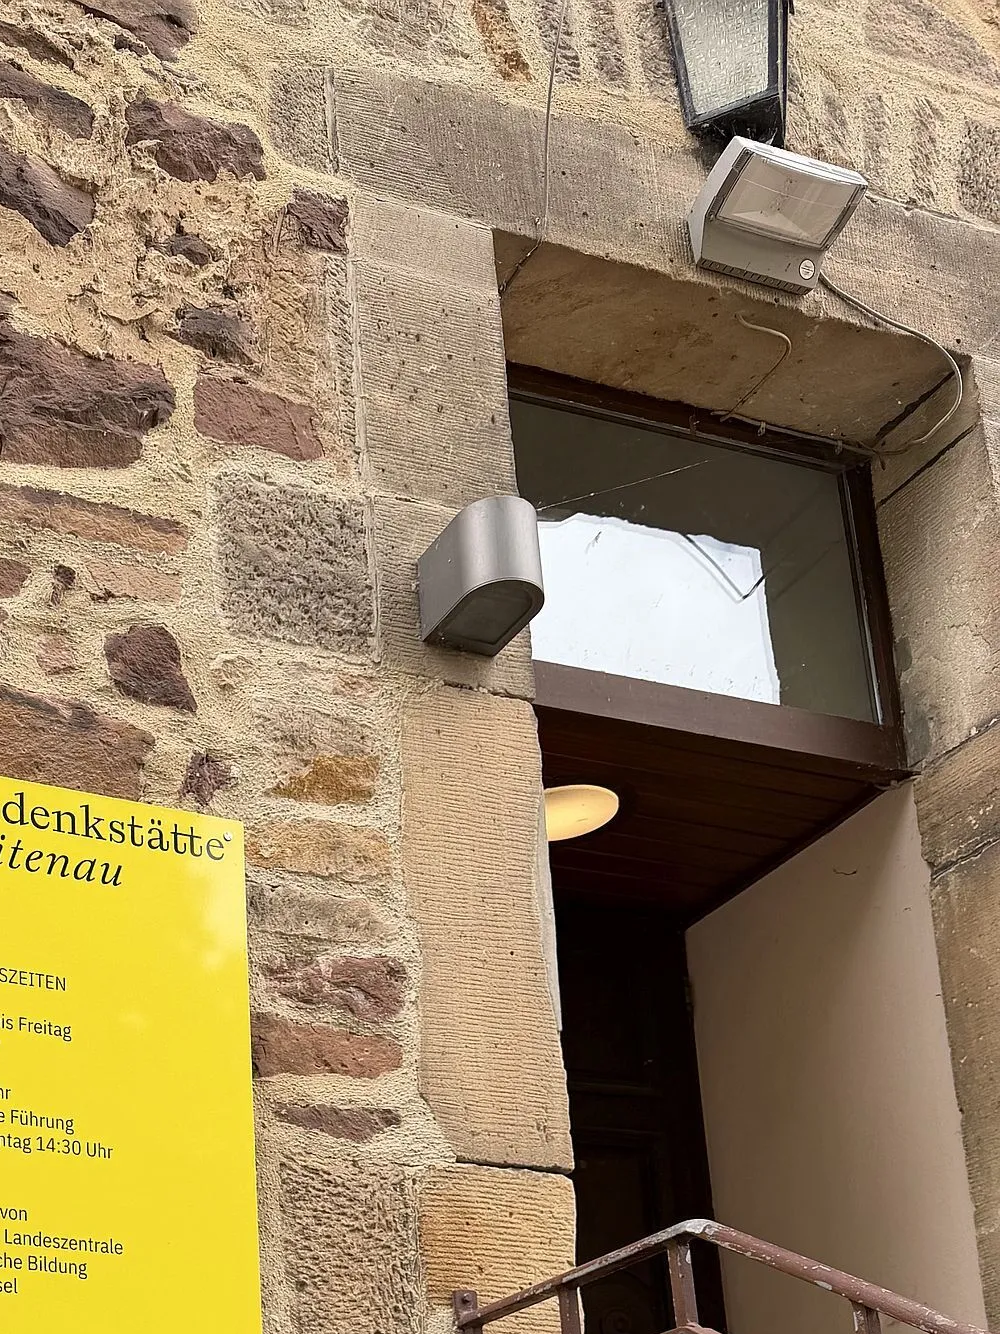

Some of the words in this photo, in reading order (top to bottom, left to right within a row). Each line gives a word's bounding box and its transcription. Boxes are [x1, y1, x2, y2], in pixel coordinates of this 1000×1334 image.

[19, 1017, 72, 1042] Freitag
[11, 1109, 74, 1135] Führung
[36, 1136, 81, 1155] 14:30
[87, 1142, 113, 1159] Uhr
[0, 1206, 27, 1221] von
[5, 1230, 123, 1255] Landeszentrale
[28, 1255, 87, 1280] Bildung
